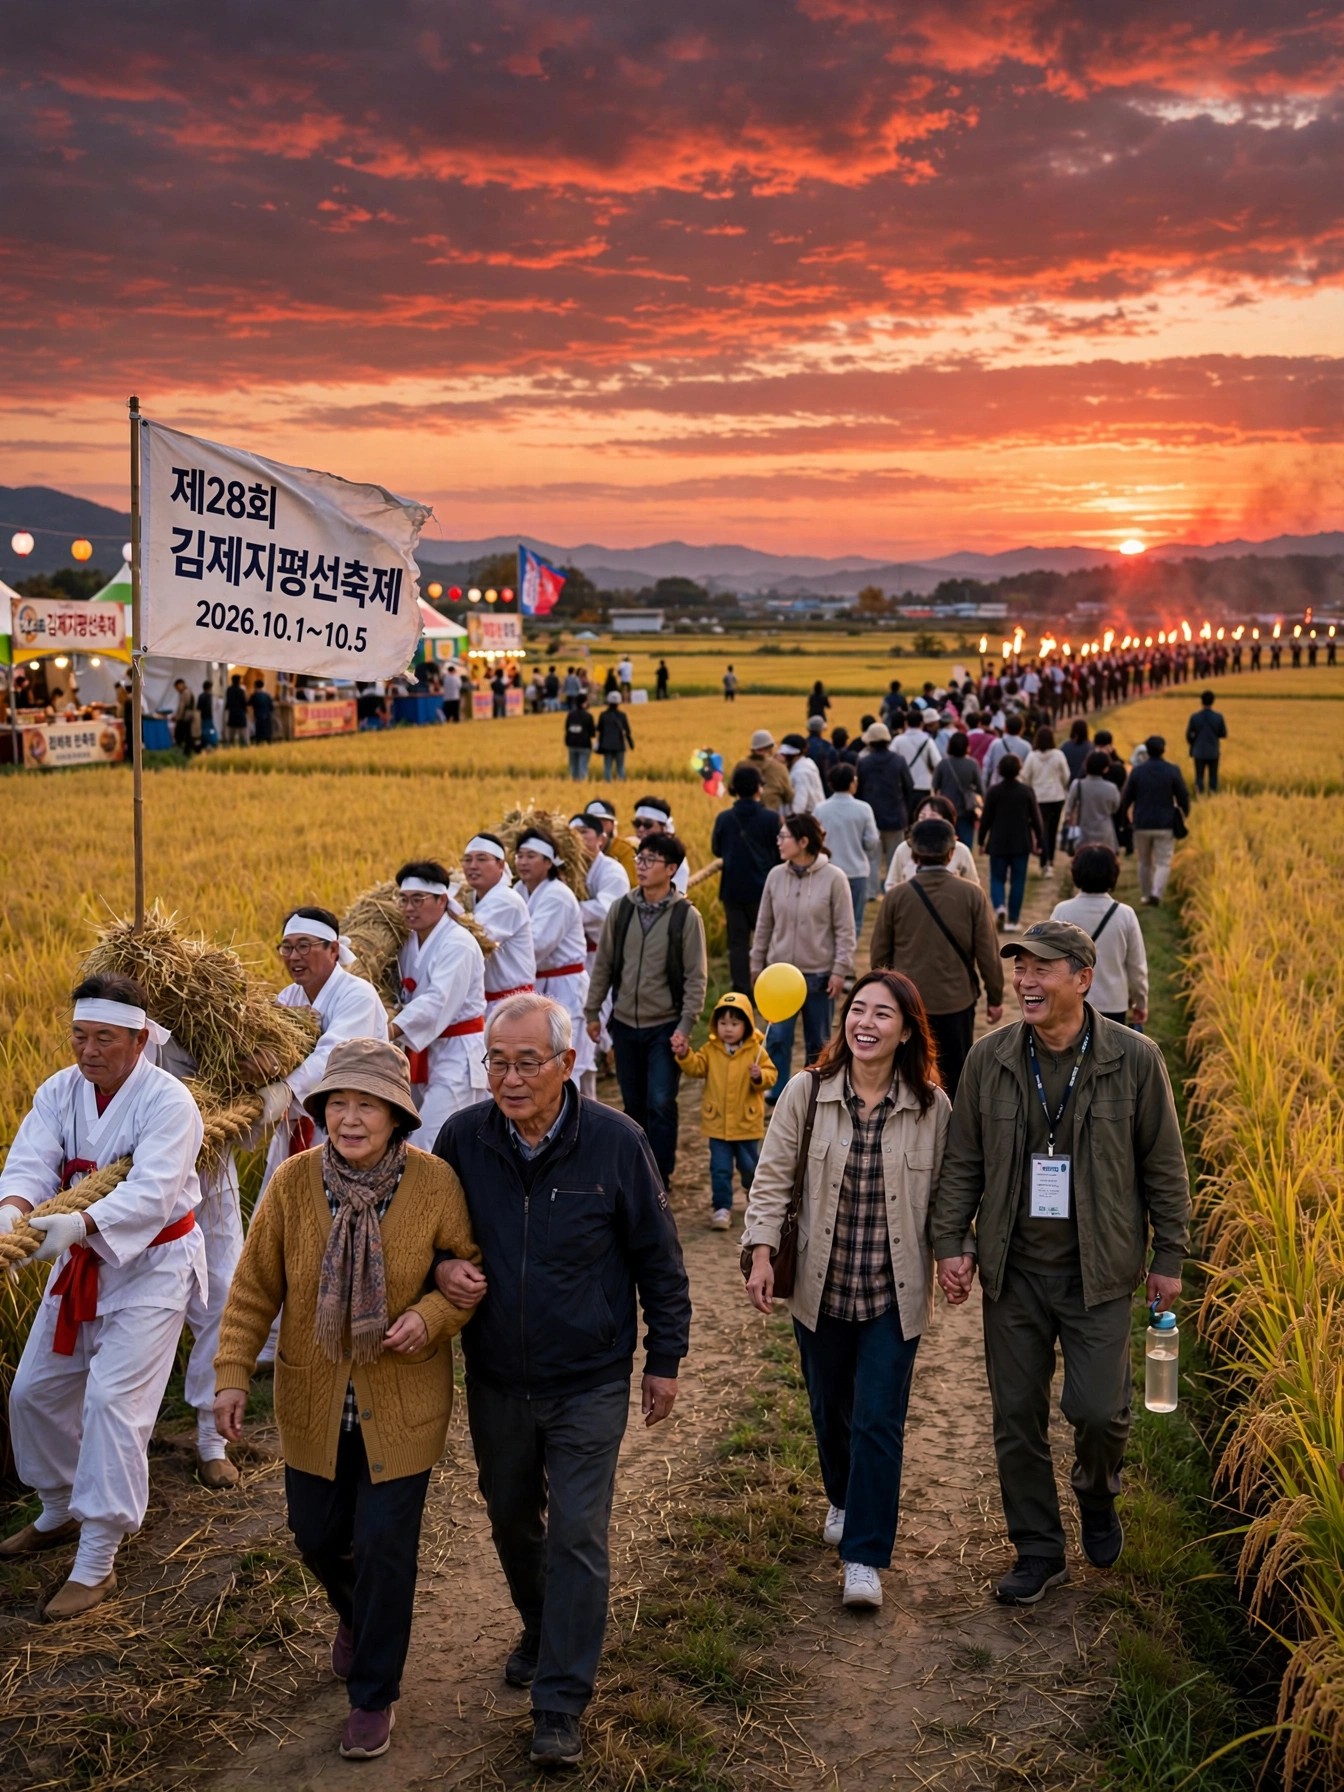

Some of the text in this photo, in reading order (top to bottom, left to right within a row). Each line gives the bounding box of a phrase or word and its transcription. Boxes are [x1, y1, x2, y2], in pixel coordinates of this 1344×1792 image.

[170, 467, 277, 530] 제28회
[170, 527, 403, 615] 김제지평선축제
[196, 600, 368, 653] 2026.10.1~10.5
